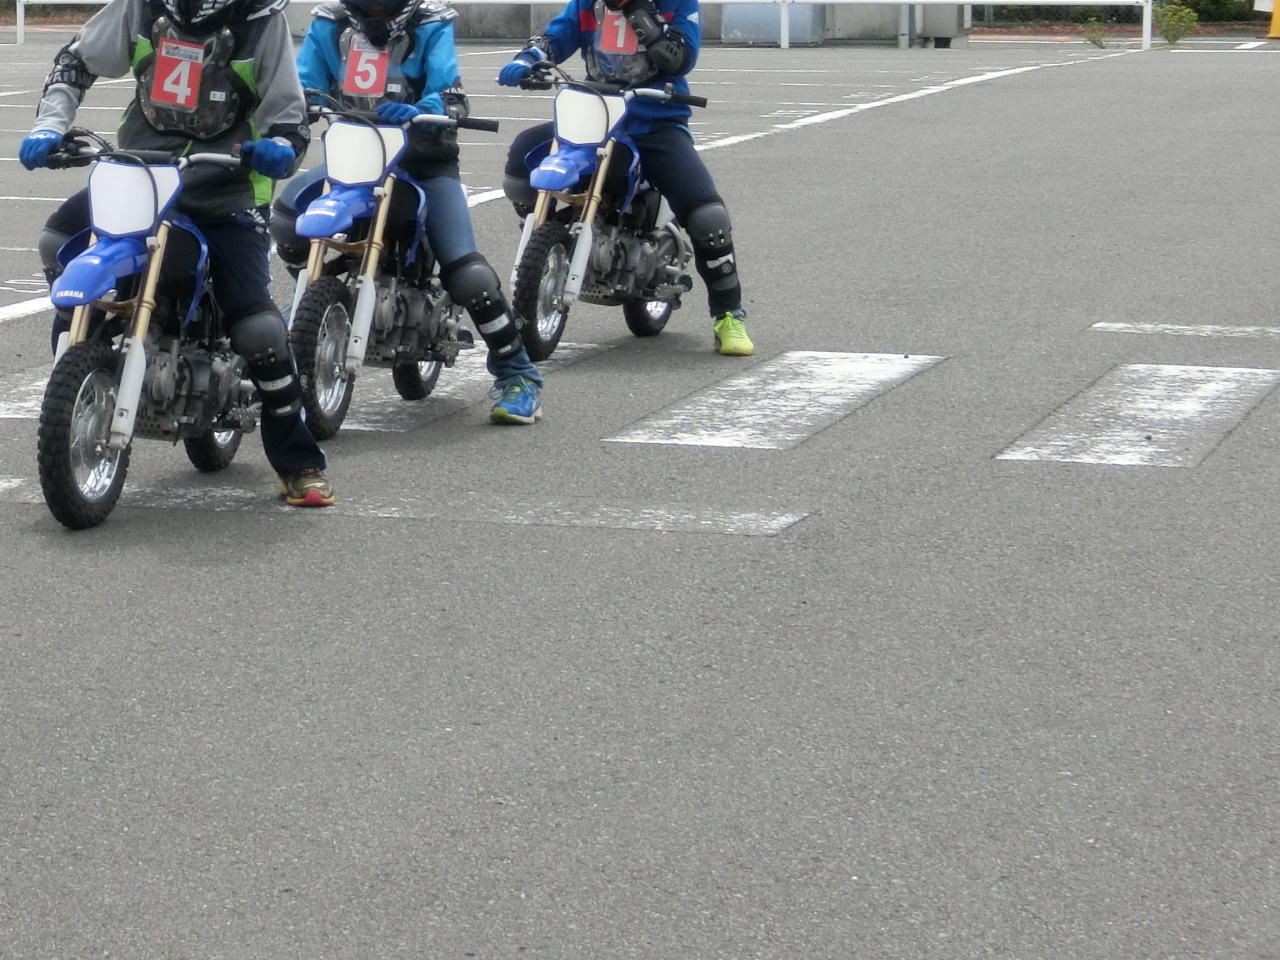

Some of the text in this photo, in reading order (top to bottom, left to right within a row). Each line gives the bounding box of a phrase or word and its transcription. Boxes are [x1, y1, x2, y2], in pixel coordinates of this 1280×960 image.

[613, 17, 627, 48] 1
[163, 60, 192, 105] 4
[354, 51, 380, 90] 5
